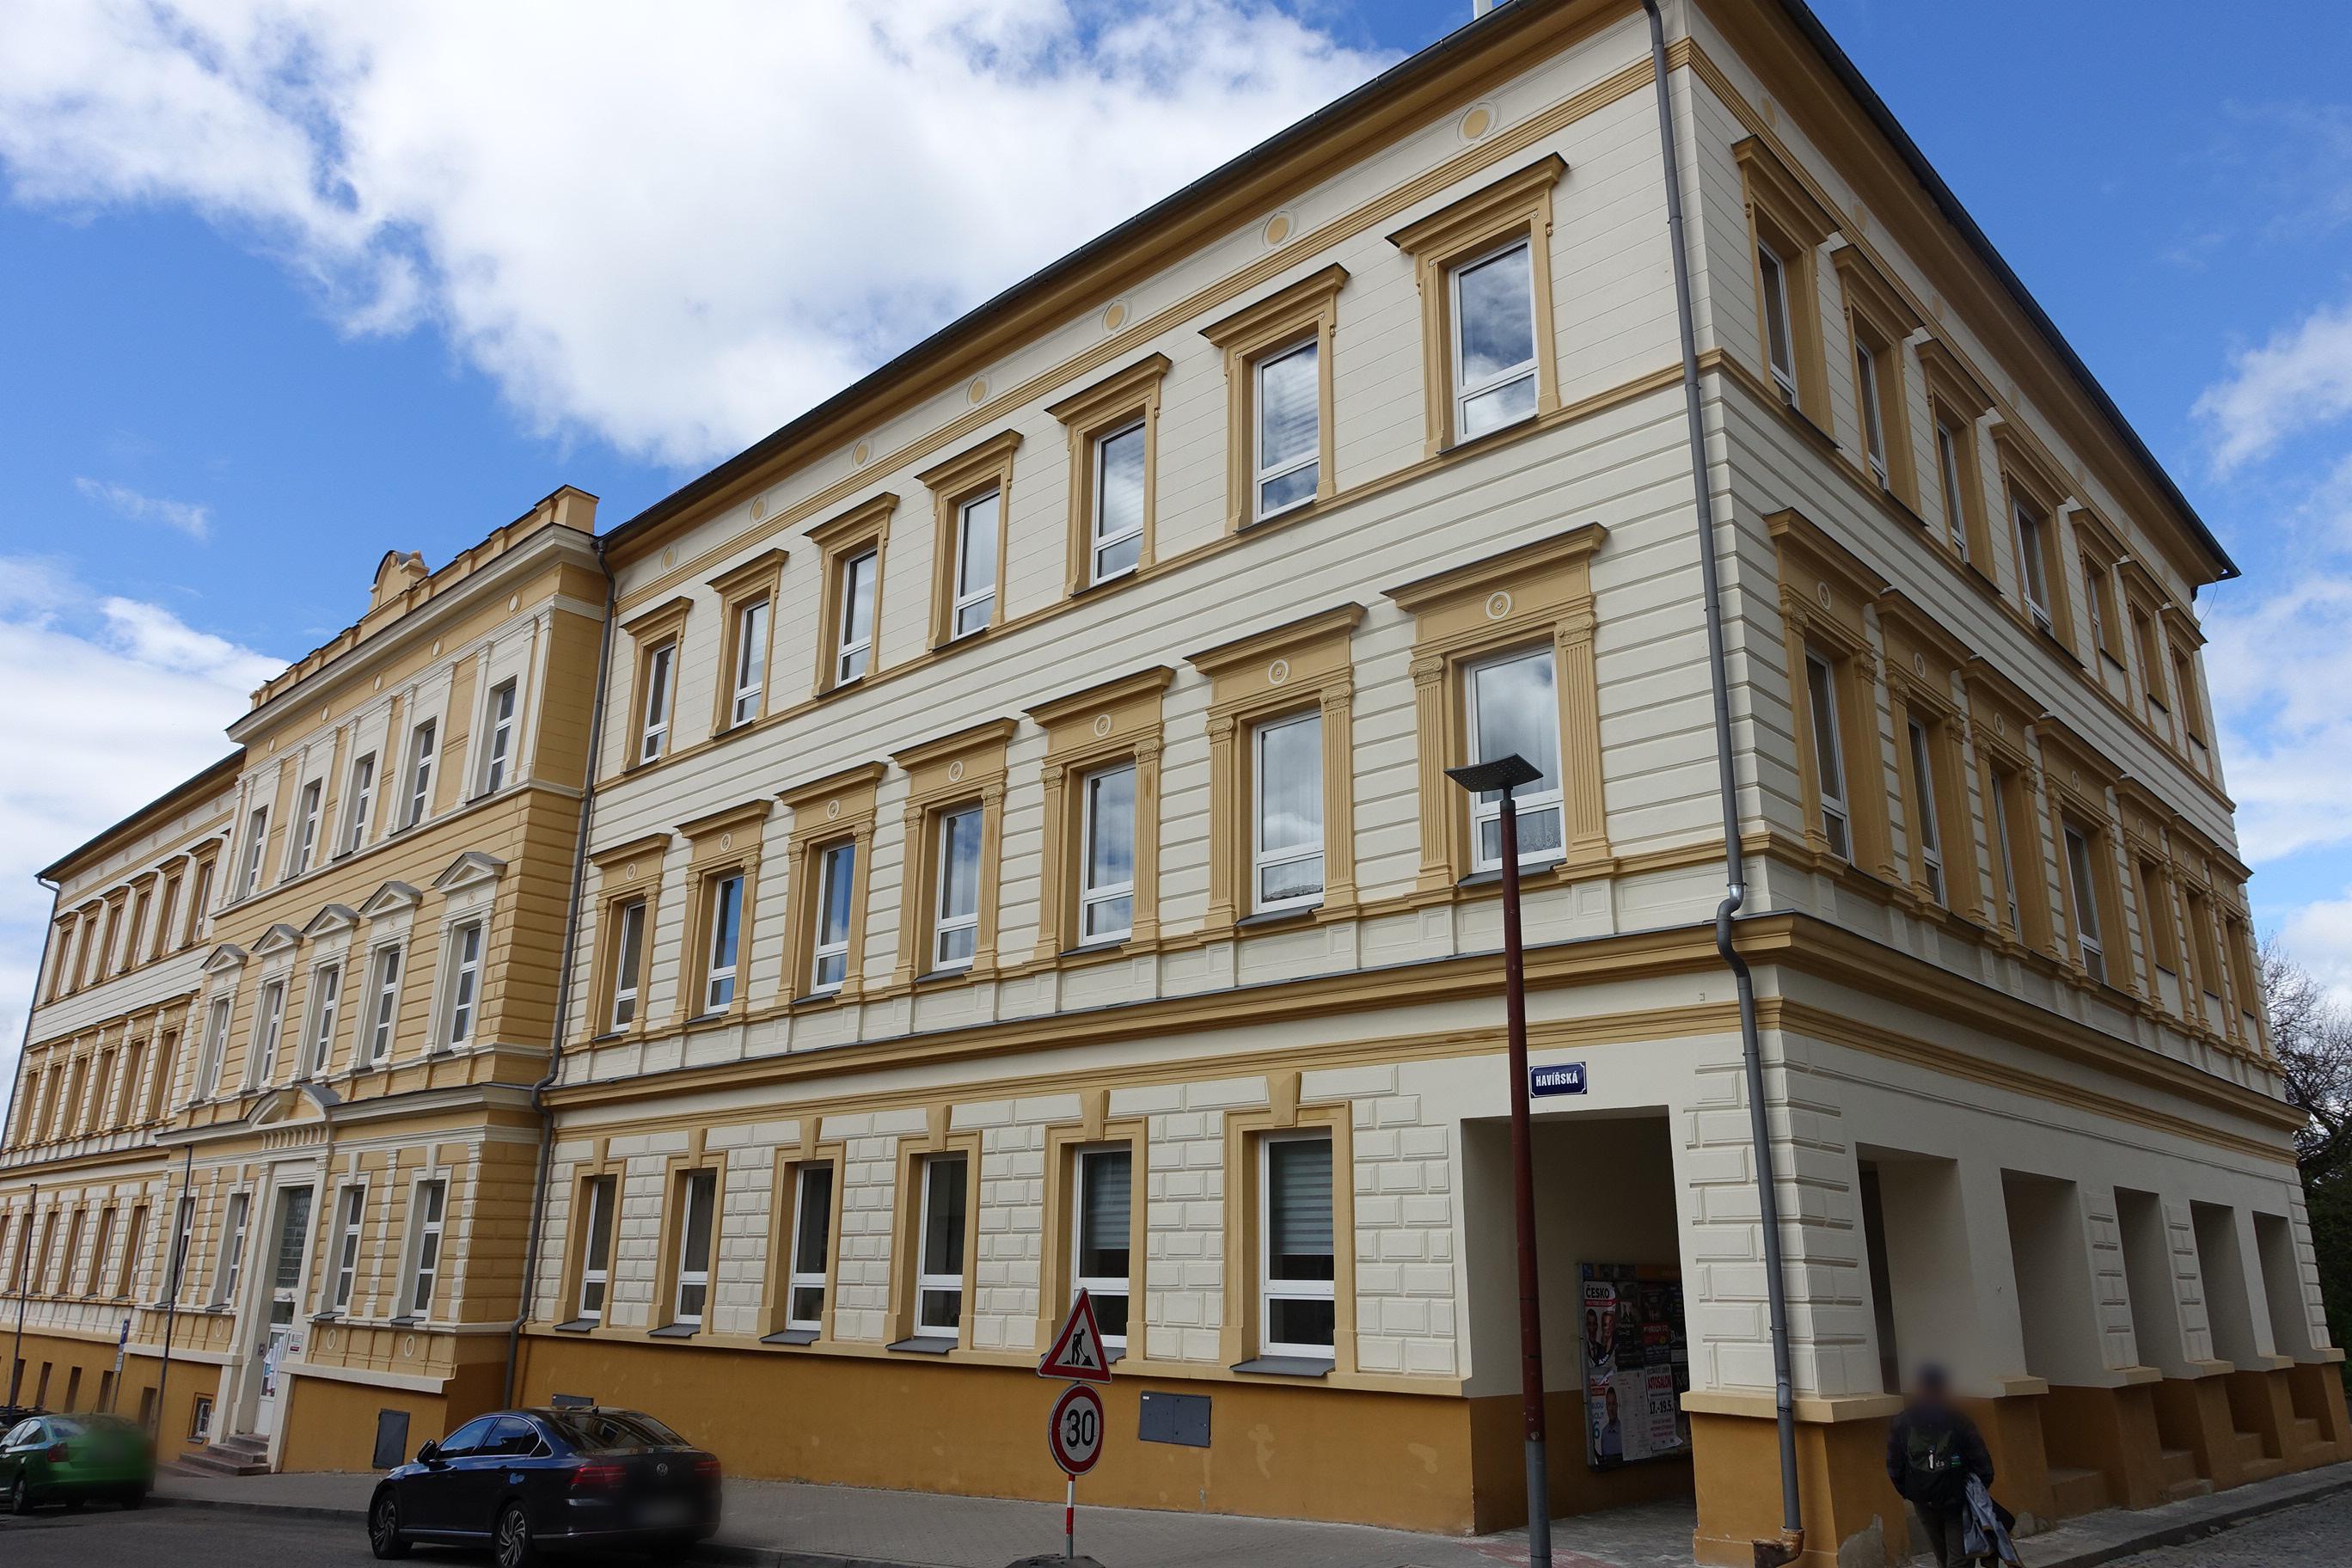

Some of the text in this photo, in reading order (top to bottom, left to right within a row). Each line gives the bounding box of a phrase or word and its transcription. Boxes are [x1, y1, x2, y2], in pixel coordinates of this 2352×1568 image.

[1535, 1071, 1578, 1087] HAVÍŘSKÁ
[1586, 1284, 1609, 1298] ČESKO
[1066, 1409, 1095, 1447] 30
